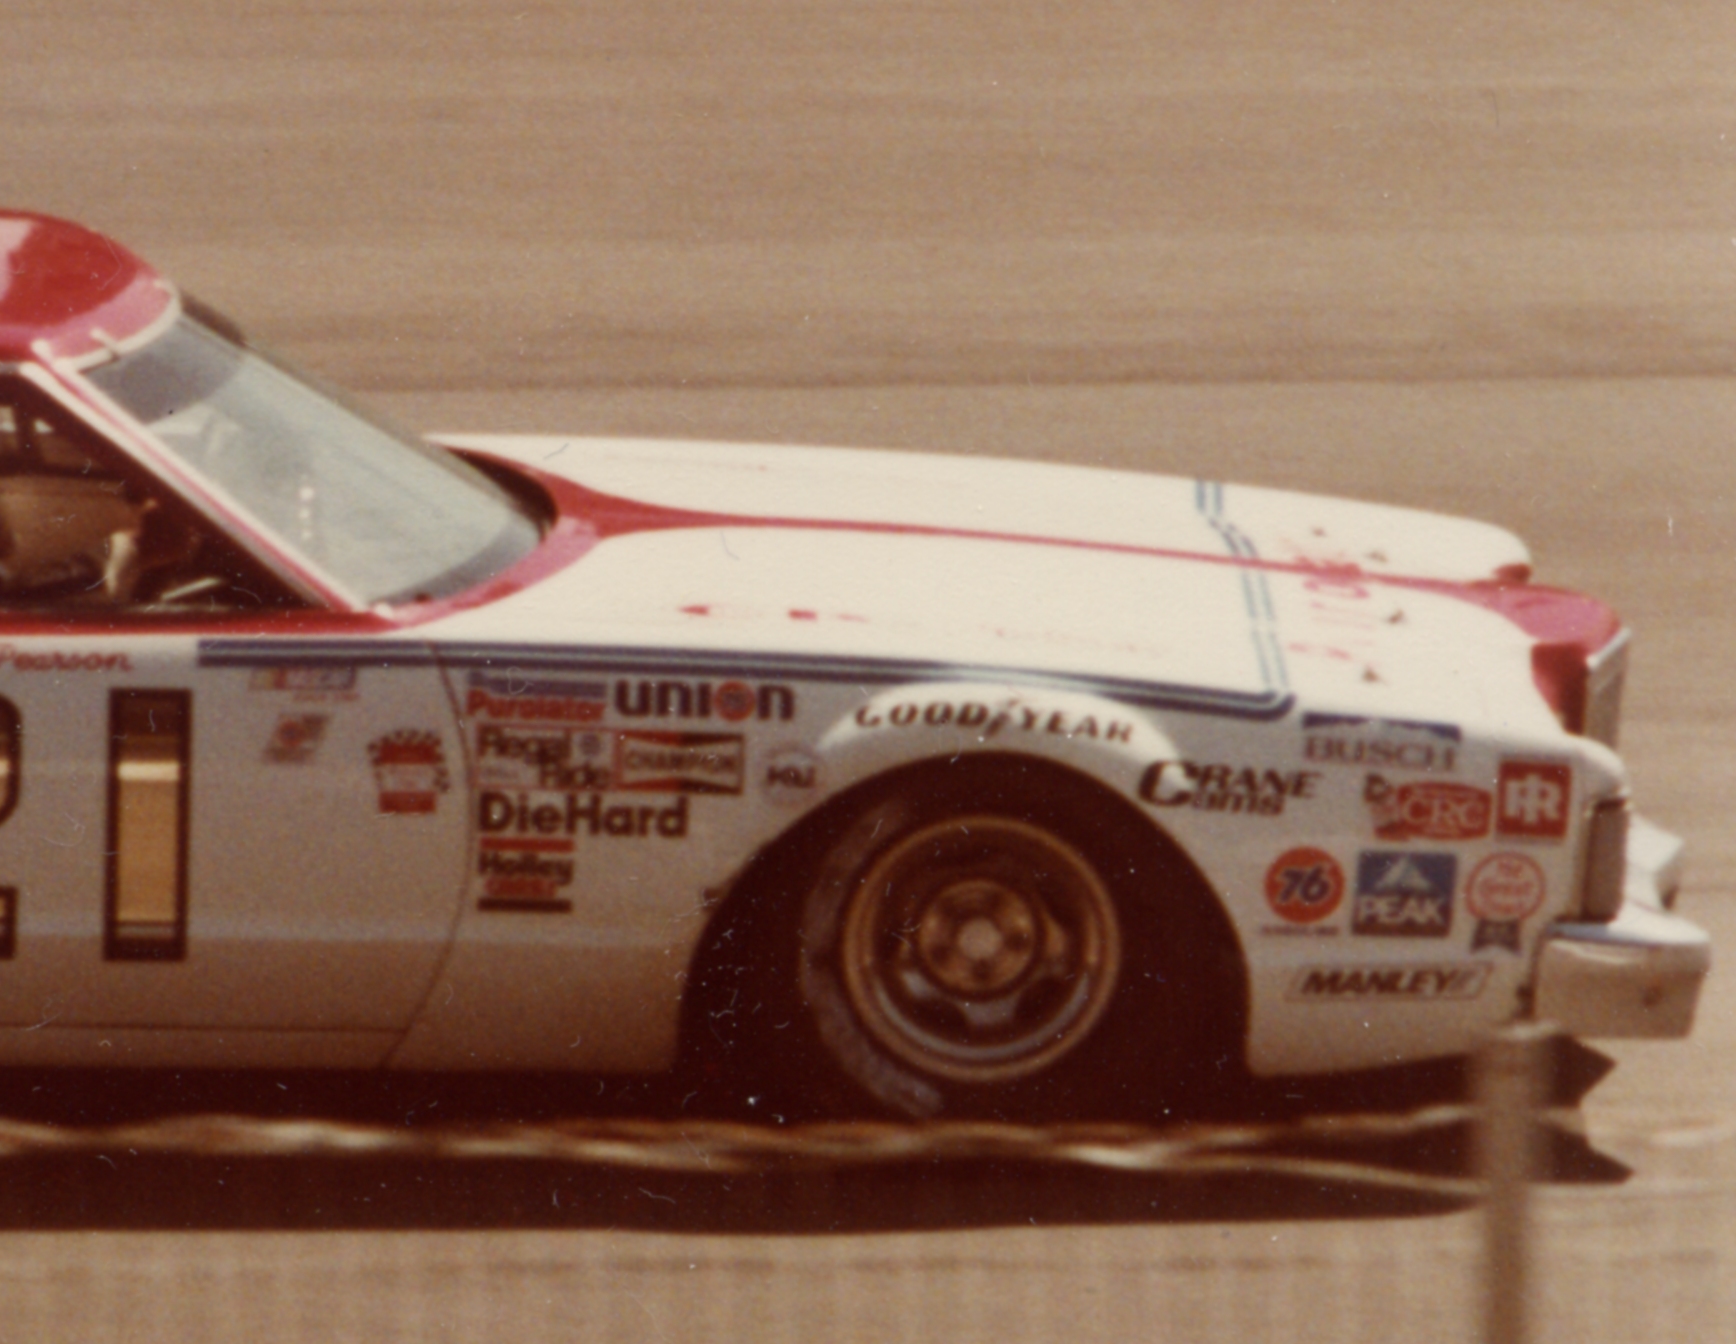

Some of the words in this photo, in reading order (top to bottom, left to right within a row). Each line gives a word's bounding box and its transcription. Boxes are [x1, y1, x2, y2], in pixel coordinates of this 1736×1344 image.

[1303, 736, 1456, 772] BUSCH
[478, 791, 689, 838] DieHard
[1400, 796, 1485, 832] CRC
[1276, 863, 1331, 905] 76
[1357, 894, 1448, 926] PEAK
[1301, 968, 1458, 996] MANLEY
